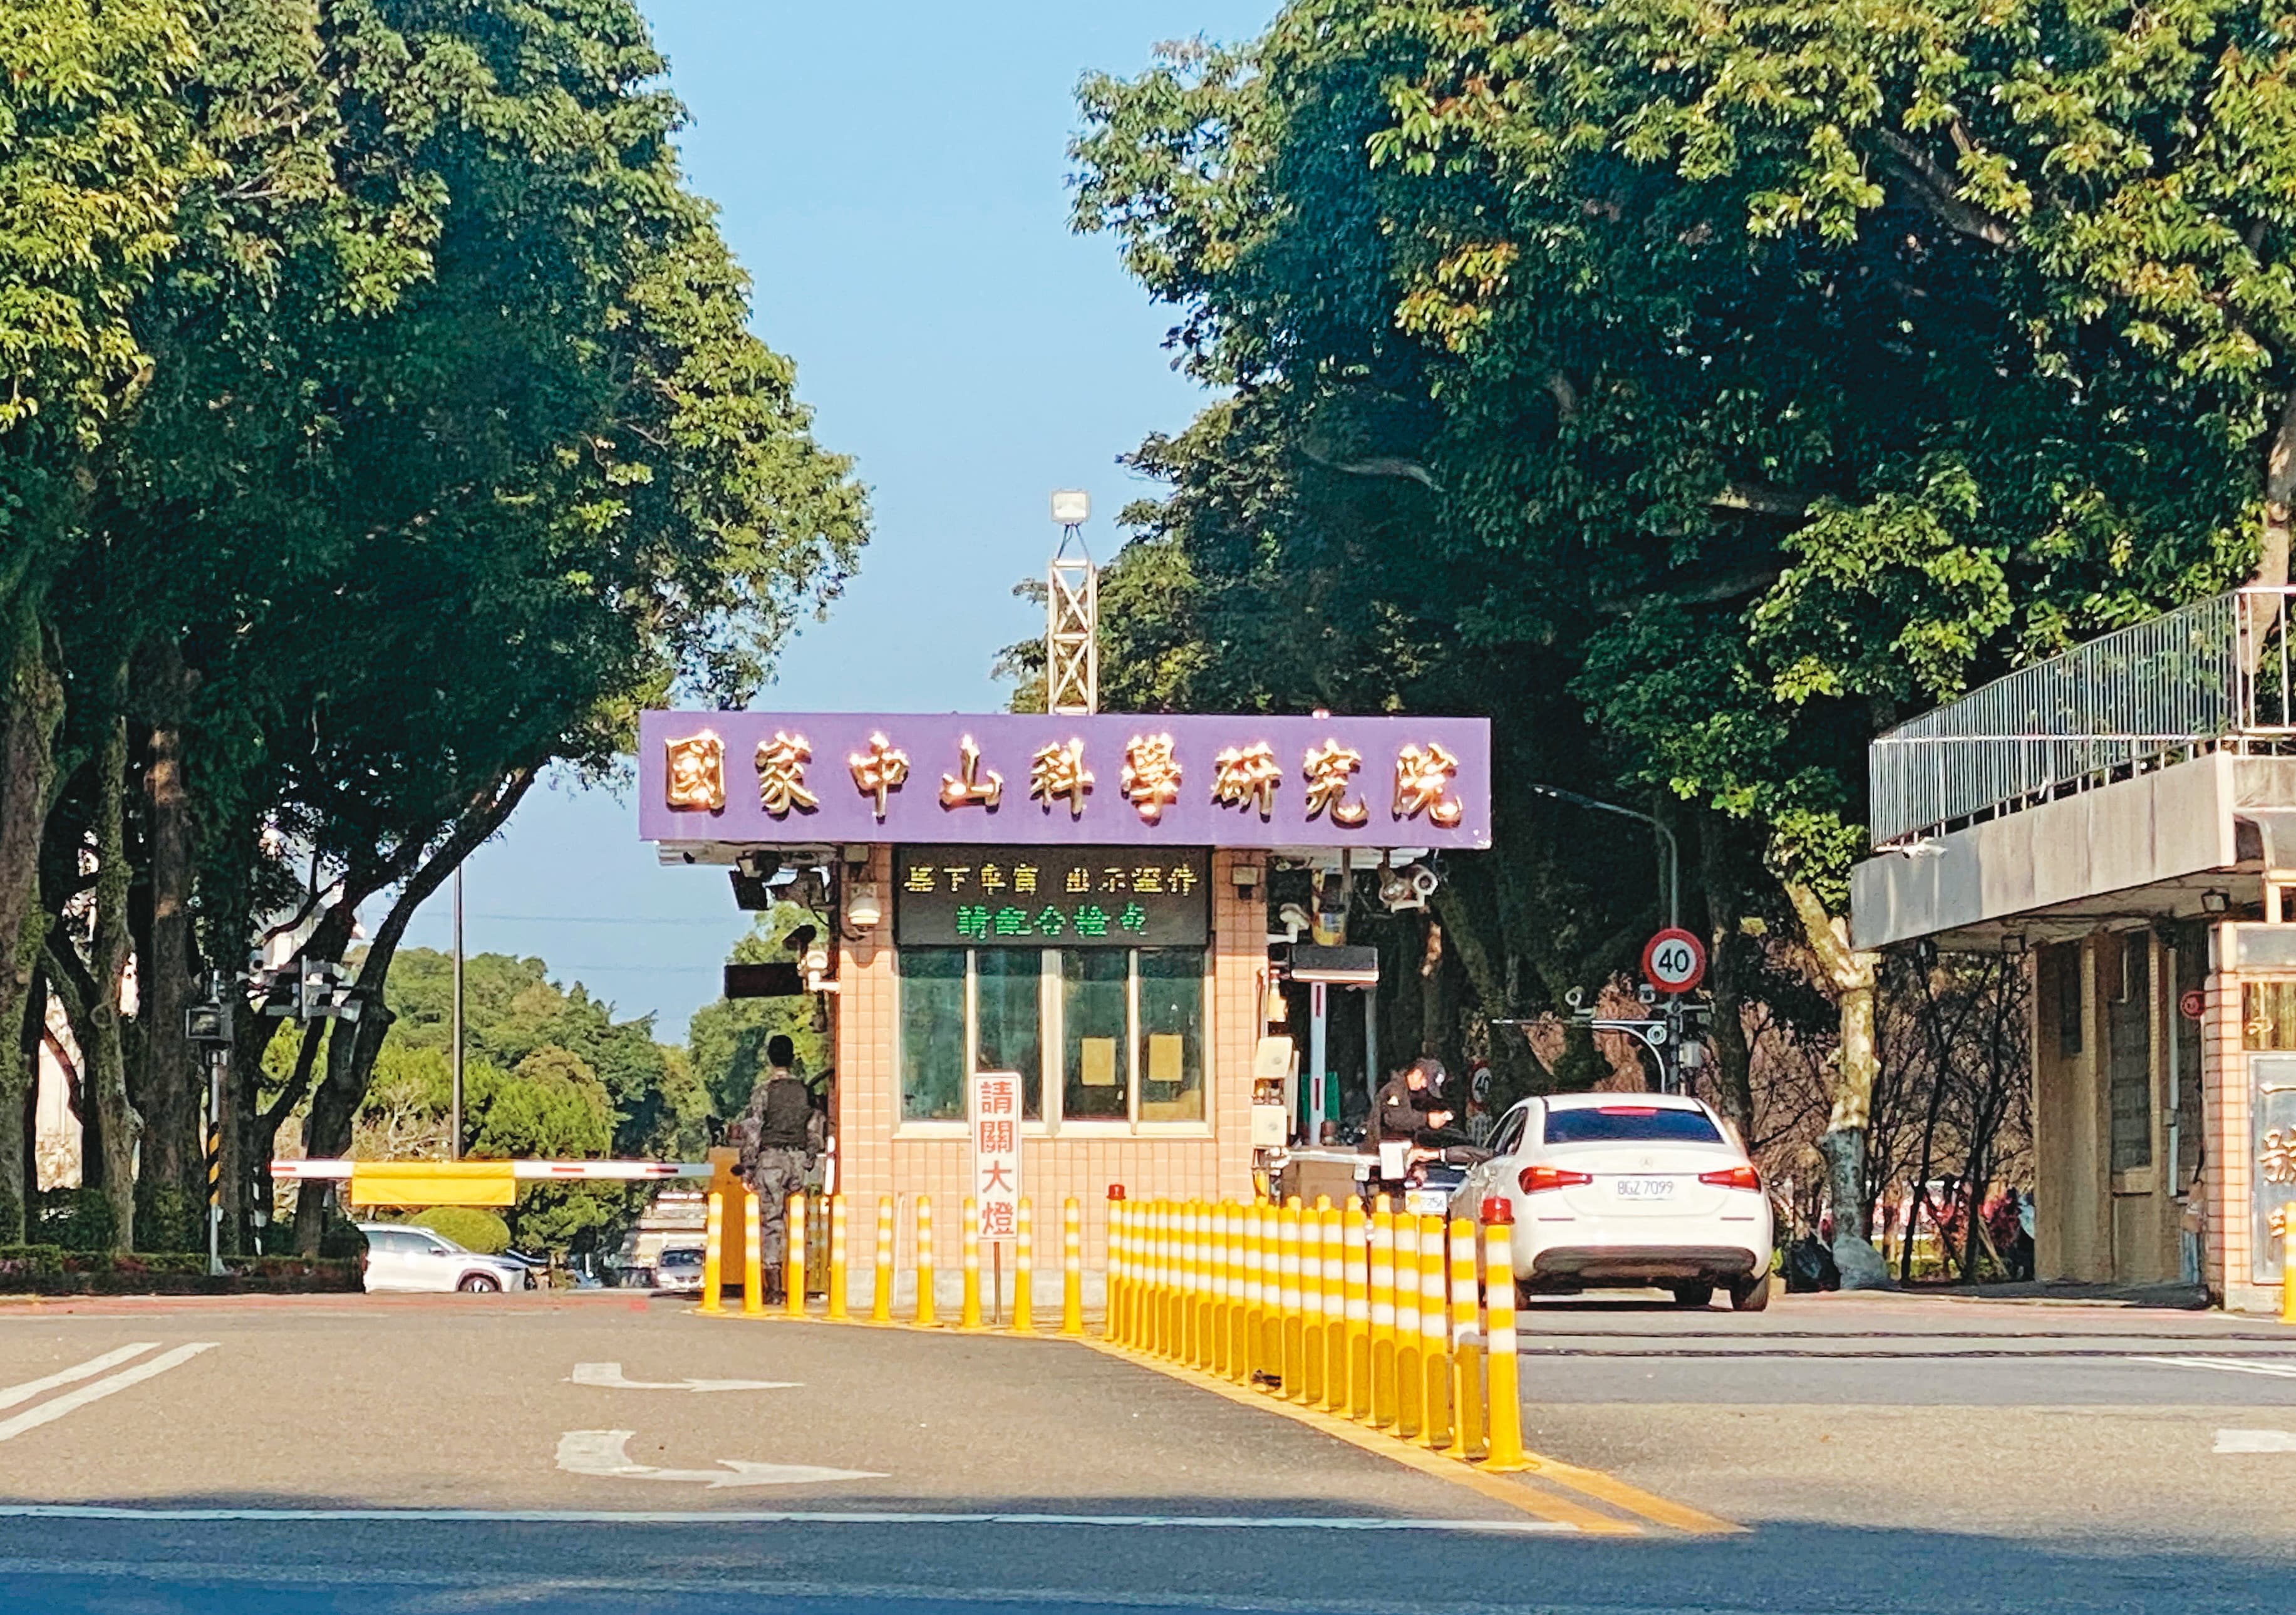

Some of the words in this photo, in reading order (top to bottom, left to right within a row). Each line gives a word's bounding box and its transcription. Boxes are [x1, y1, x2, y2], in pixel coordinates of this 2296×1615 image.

[664, 730, 1463, 828] 國家中山科學研究院
[1658, 947, 1690, 973] 40
[980, 1081, 1014, 1236] 請關大燈
